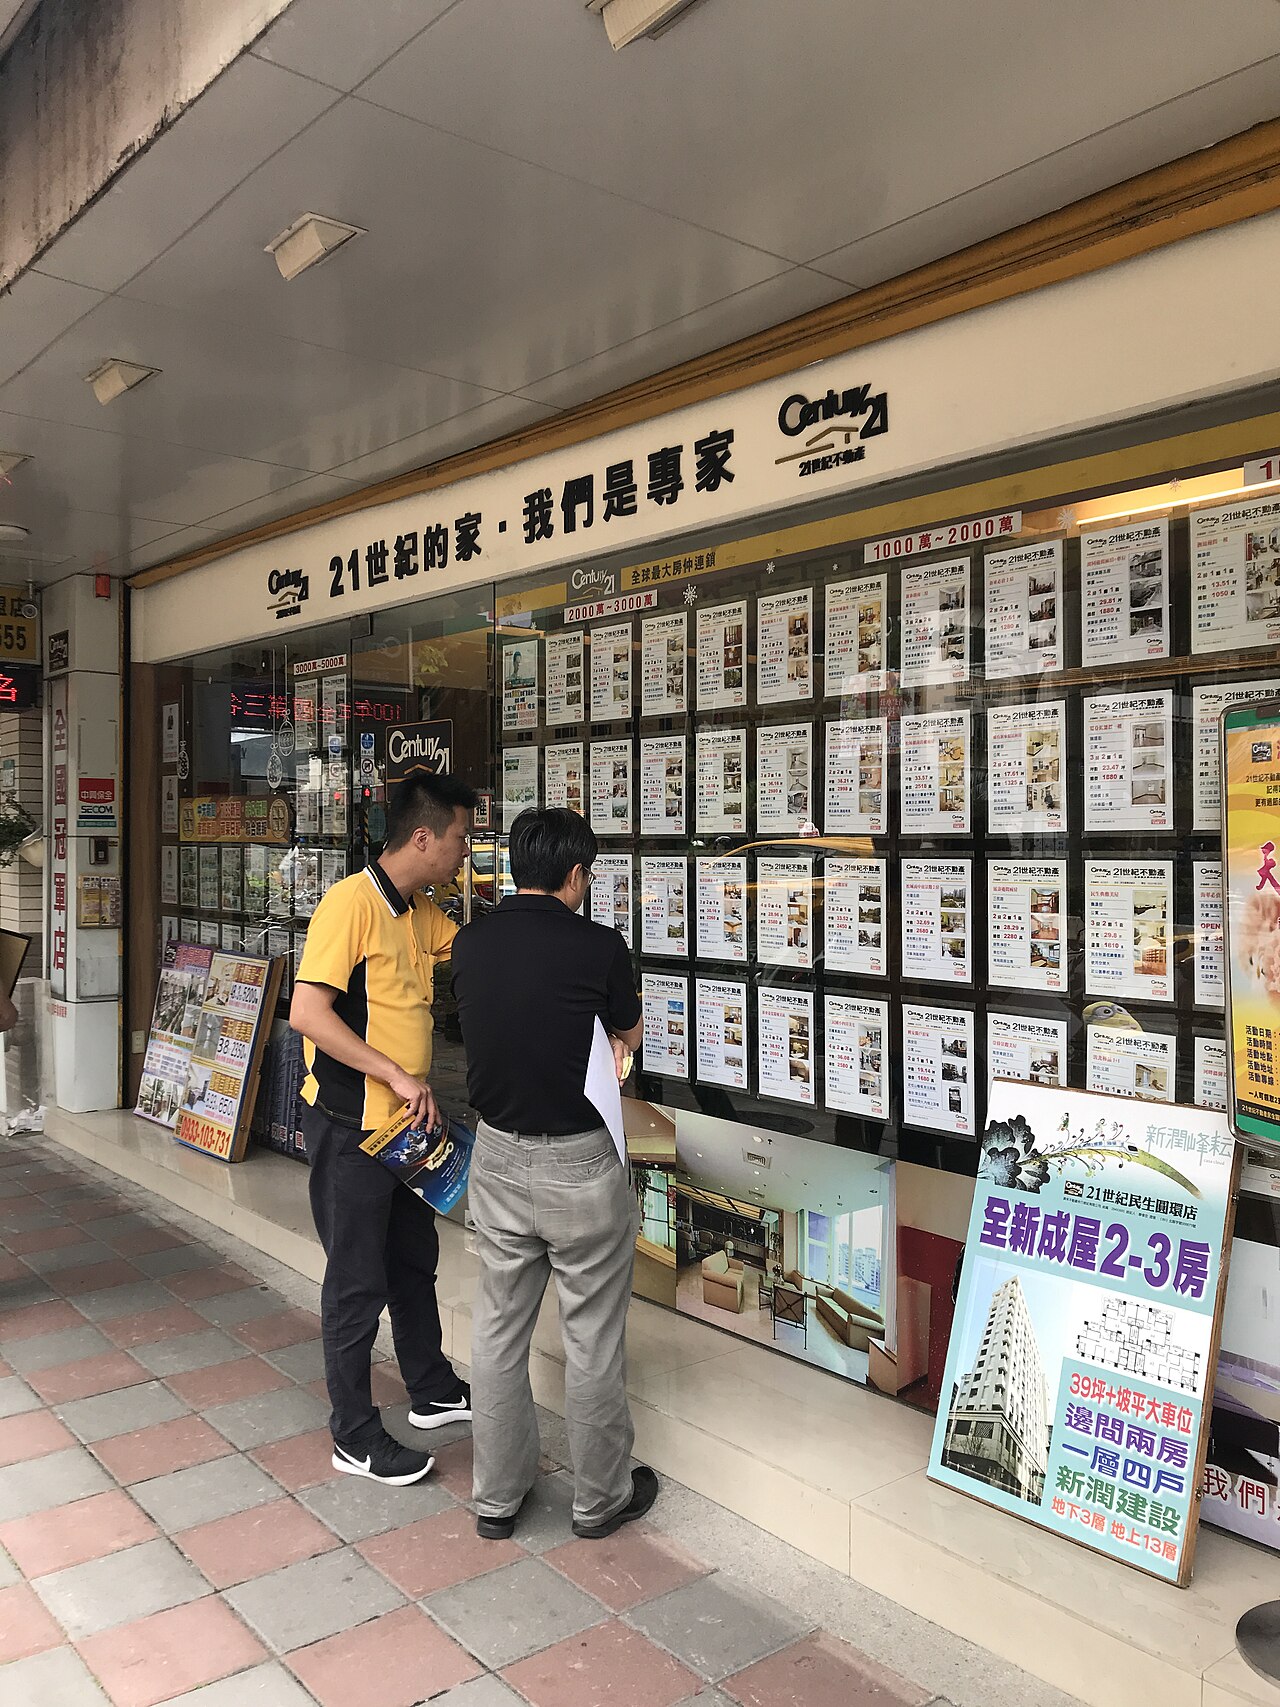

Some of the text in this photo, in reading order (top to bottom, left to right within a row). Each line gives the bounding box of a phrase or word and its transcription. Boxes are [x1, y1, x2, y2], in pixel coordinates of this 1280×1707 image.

[778, 382, 889, 440] Century 21
[873, 515, 1014, 560] 1000萬~2000萬
[571, 568, 615, 596] Century 21
[631, 552, 716, 586] 全球最大房仲連鎖
[568, 593, 653, 622] 2000萬~3000萬
[1211, 590, 1229, 598] 1050
[295, 656, 345, 674] 3000萬~5000萬
[389, 730, 441, 763] Century
[434, 747, 450, 775] 21
[80, 805, 113, 814] SECOM
[1200, 922, 1221, 930] OPEN
[216, 1037, 230, 1056] 38
[180, 1115, 232, 1157] 0933-103-731
[979, 1195, 1211, 1299] 全新成屋2-3房
[1069, 1372, 1194, 1434] 39坪+坡平大車位
[1064, 1402, 1189, 1469] 邊間兩房
[1061, 1443, 1185, 1494] 一層四戶
[1055, 1465, 1181, 1537] 新潤建設
[1203, 1467, 1280, 1521] 我們
[1051, 1495, 1178, 1562] 地下3層 地上13層
